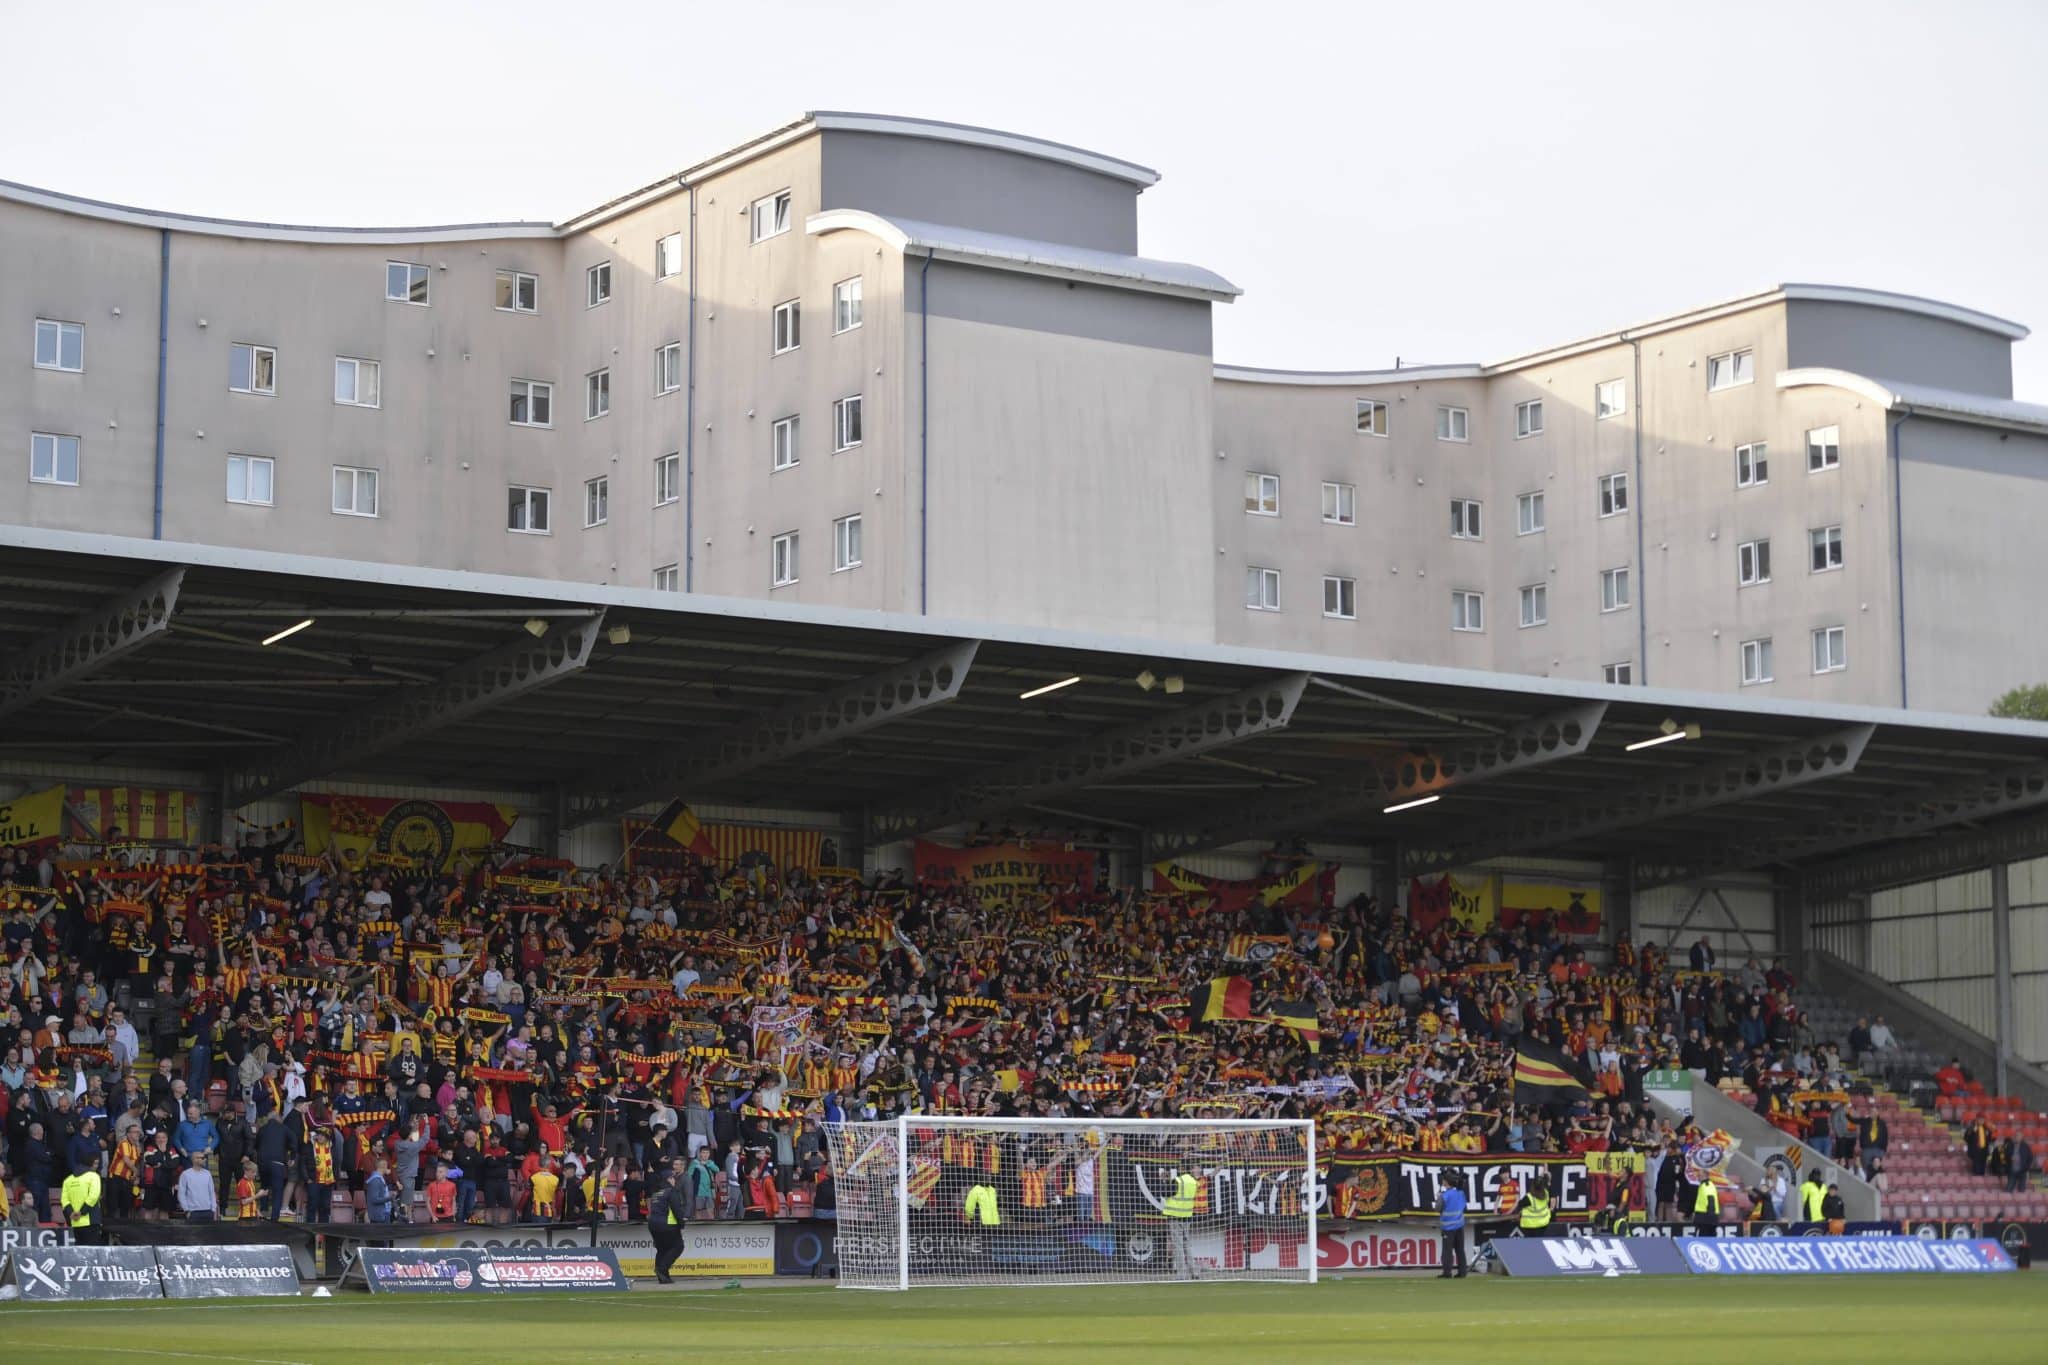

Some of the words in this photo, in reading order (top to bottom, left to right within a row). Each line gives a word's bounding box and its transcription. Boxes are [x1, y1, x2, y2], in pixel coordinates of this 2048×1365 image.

[402, 1062, 416, 1072] 93
[600, 1239, 653, 1250] www.nor
[695, 1237, 717, 1249] 0141
[720, 1237, 742, 1249] 353
[744, 1237, 770, 1249] 9557
[1716, 1242, 1822, 1271] FORREST
[1817, 1241, 1936, 1270] PRECISION
[1928, 1243, 1988, 1269] ENG.
[530, 1265, 561, 1277] 280
[564, 1265, 607, 1277] 0494
[697, 1262, 726, 1270] Solutions
[62, 1265, 90, 1282] PZ
[94, 1263, 149, 1285] Tiling
[175, 1262, 291, 1280] Maintenance
